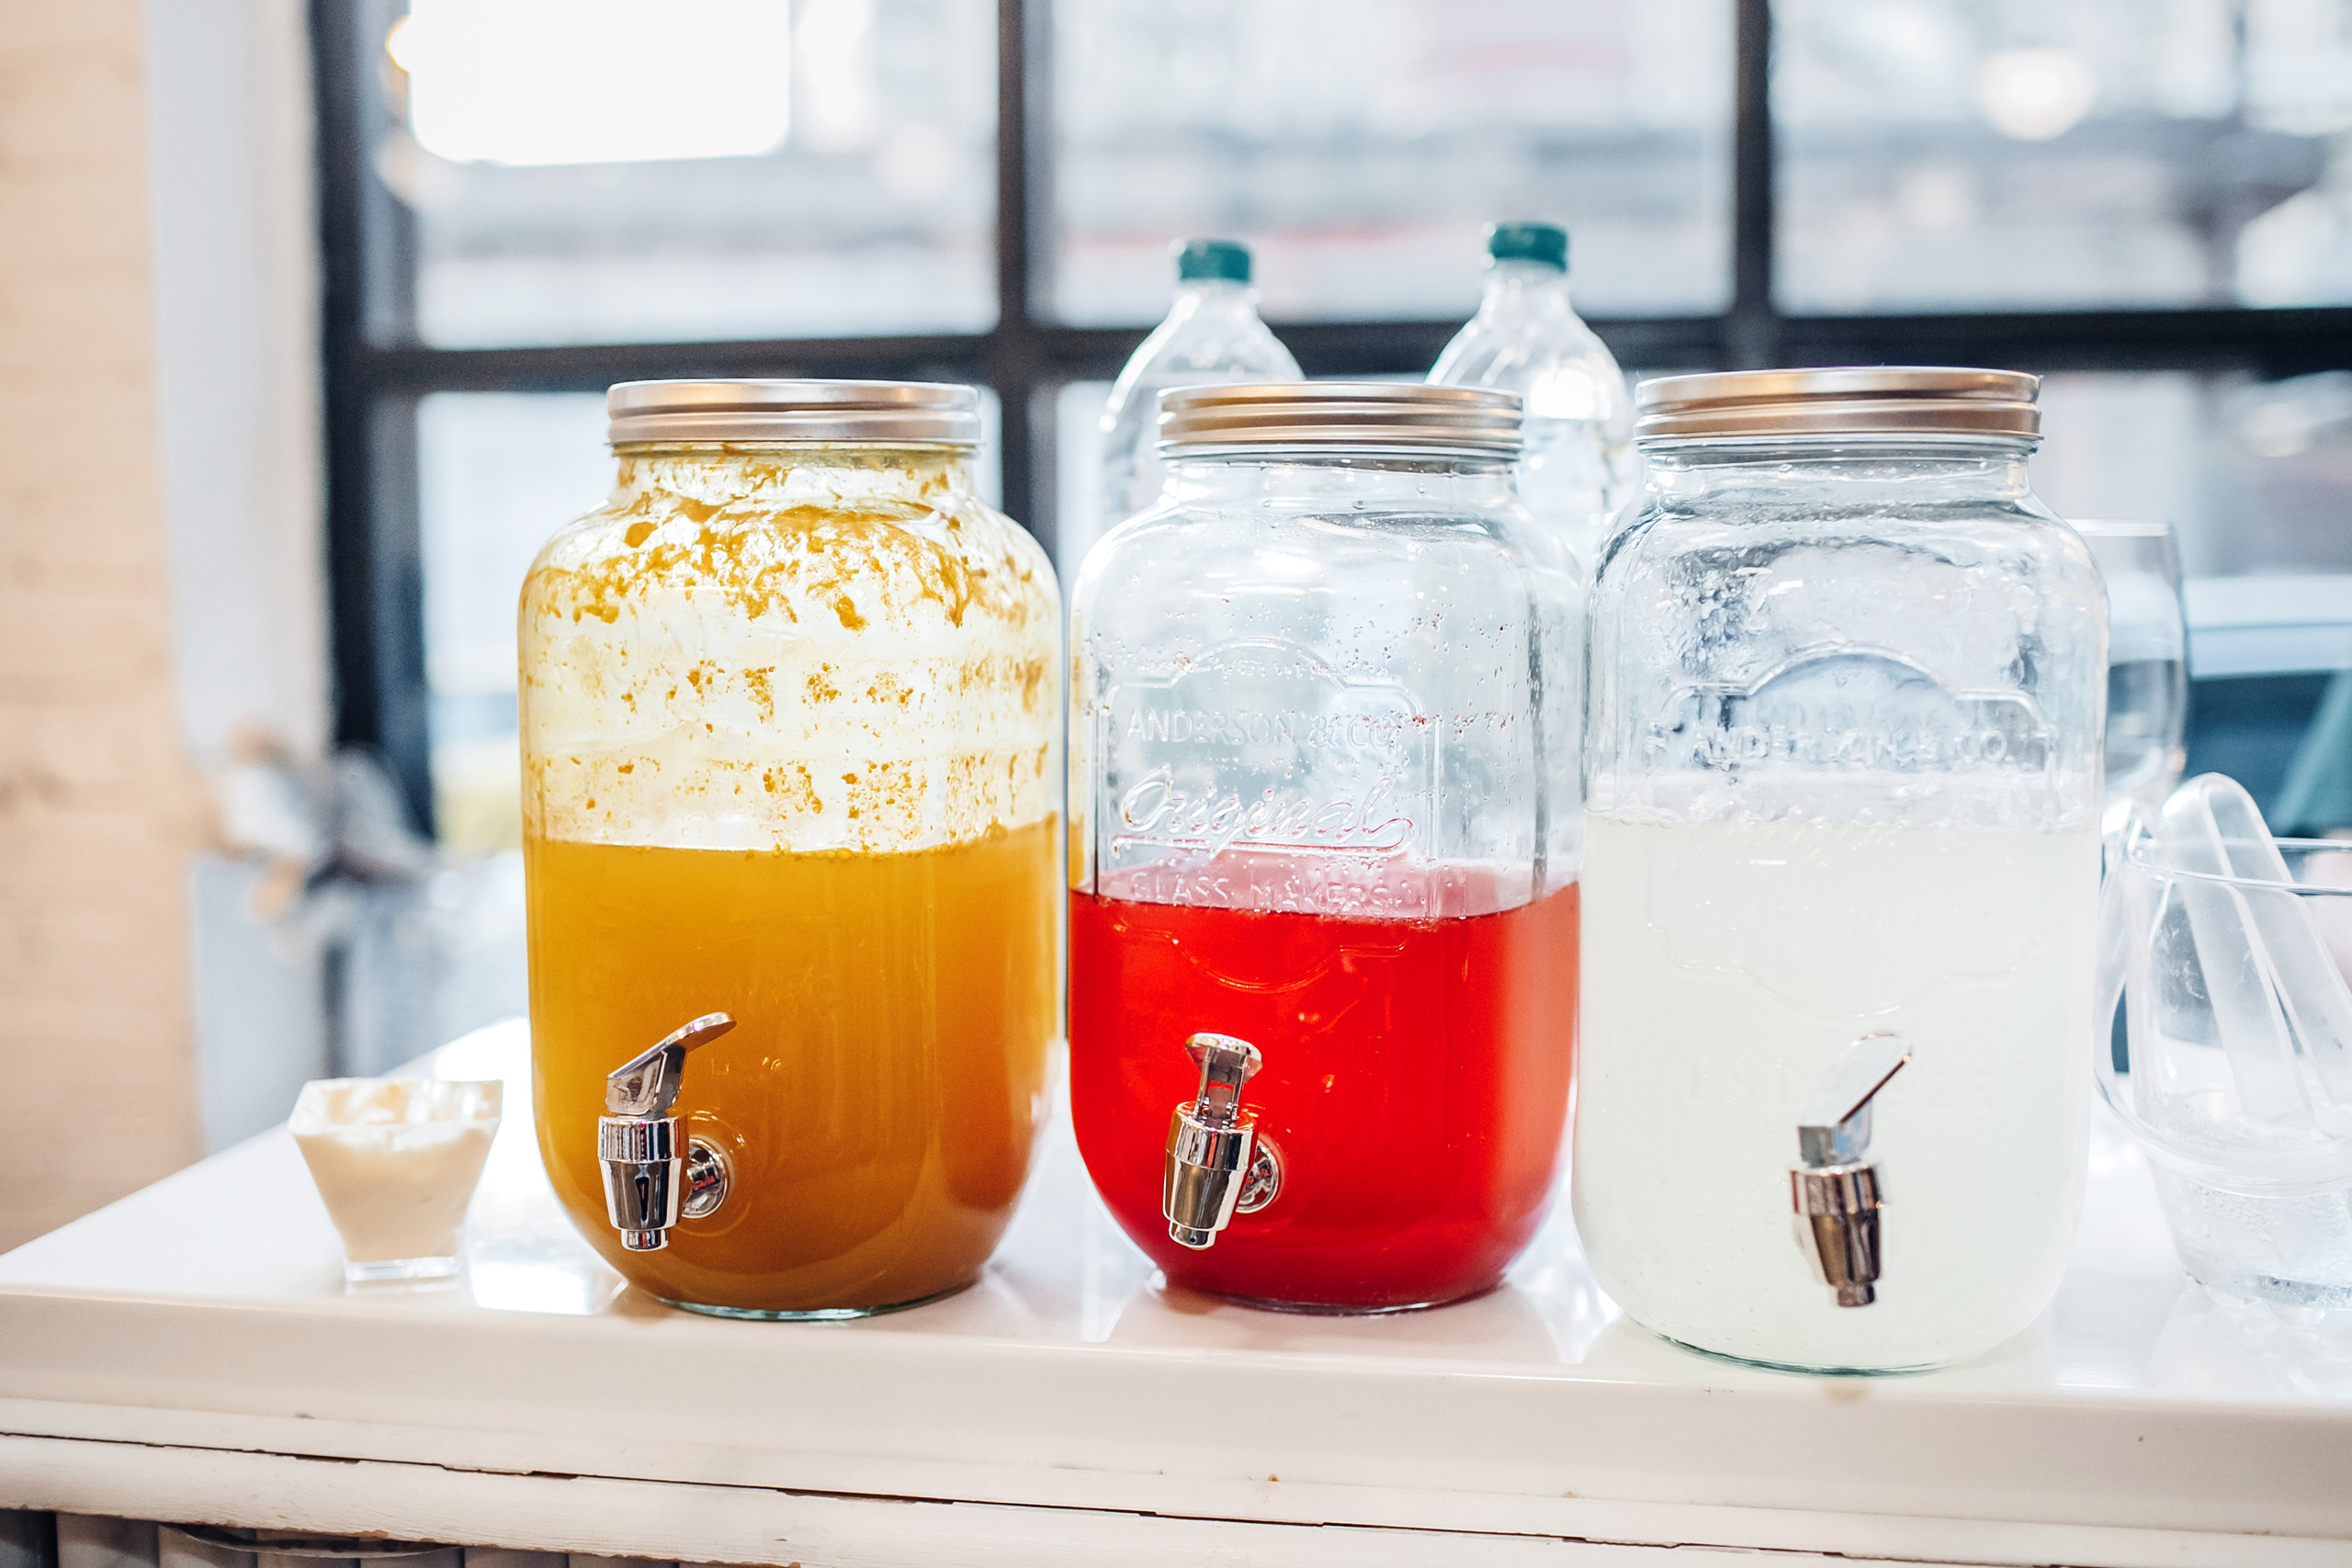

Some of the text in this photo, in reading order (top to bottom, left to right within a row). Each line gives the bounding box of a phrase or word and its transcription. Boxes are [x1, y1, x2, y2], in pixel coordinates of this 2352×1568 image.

[1126, 707, 1296, 747] ANDERSON
[1307, 716, 1338, 749] &
[1120, 763, 1415, 859] Original
[1130, 872, 1391, 916] GLASS MAKERS
